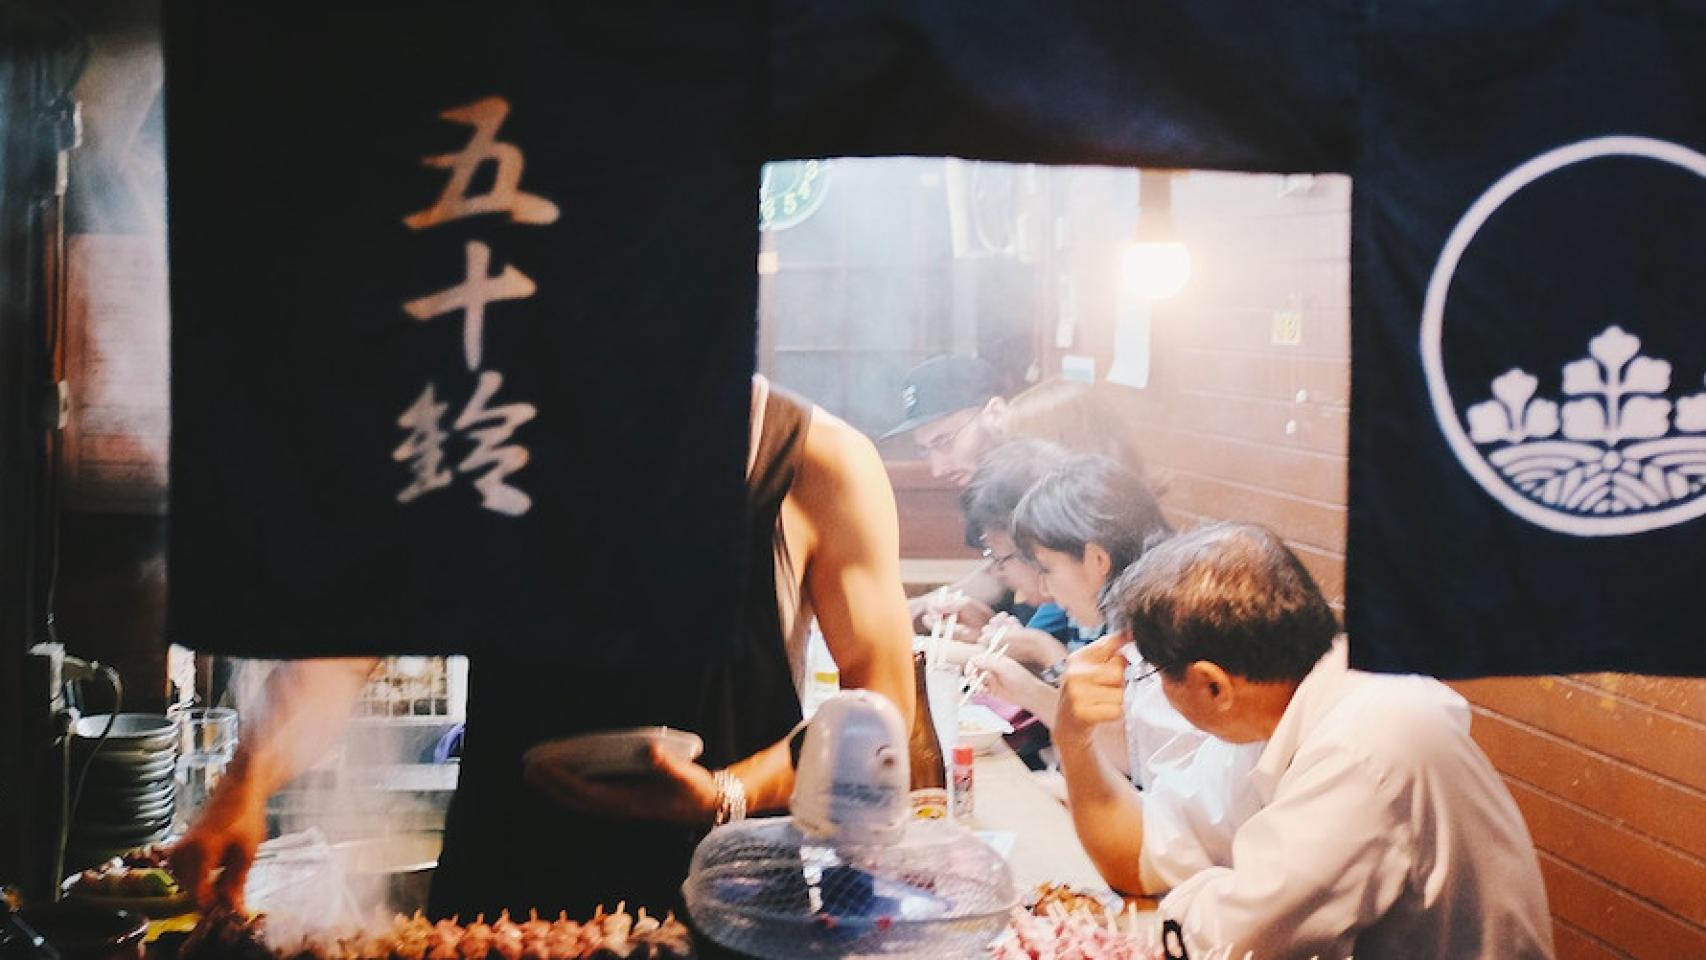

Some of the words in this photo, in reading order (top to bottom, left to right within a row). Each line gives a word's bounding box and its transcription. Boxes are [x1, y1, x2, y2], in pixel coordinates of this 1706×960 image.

[391, 96, 560, 516] 五十鈴
[783, 192, 798, 216] 5
